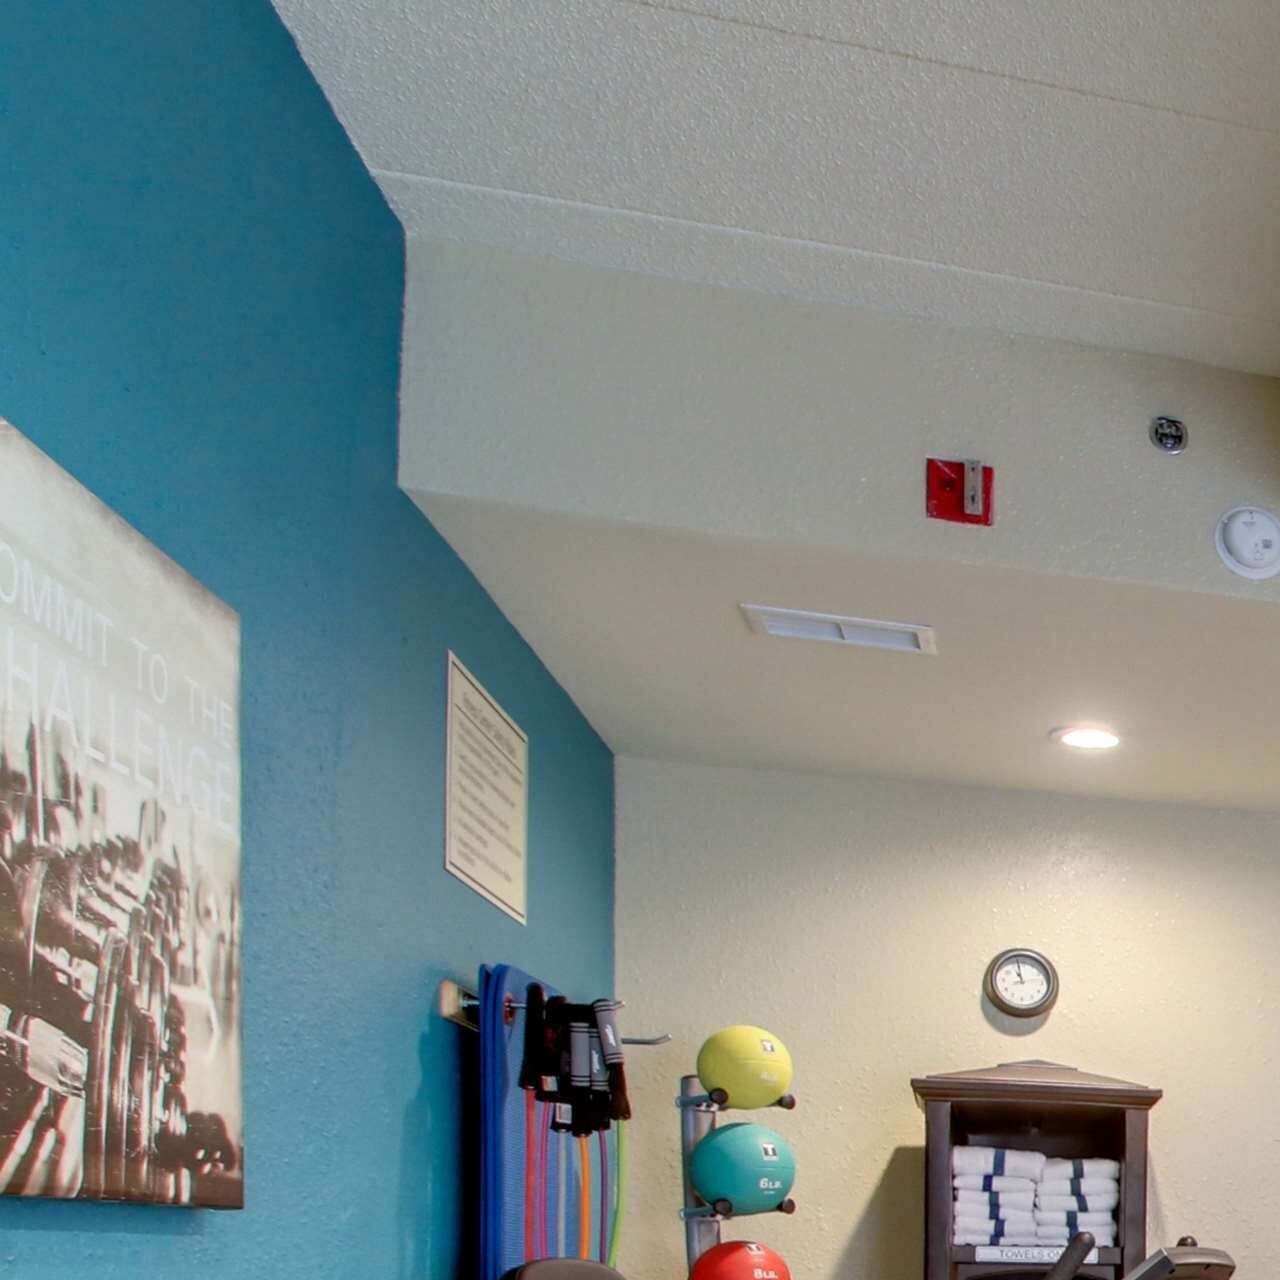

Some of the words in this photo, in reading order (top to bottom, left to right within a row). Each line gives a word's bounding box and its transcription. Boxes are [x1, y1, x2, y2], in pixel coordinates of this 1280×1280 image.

[128, 637, 168, 704] TO
[184, 675, 233, 750] THE
[1000, 1249, 1042, 1259] TOWELS
